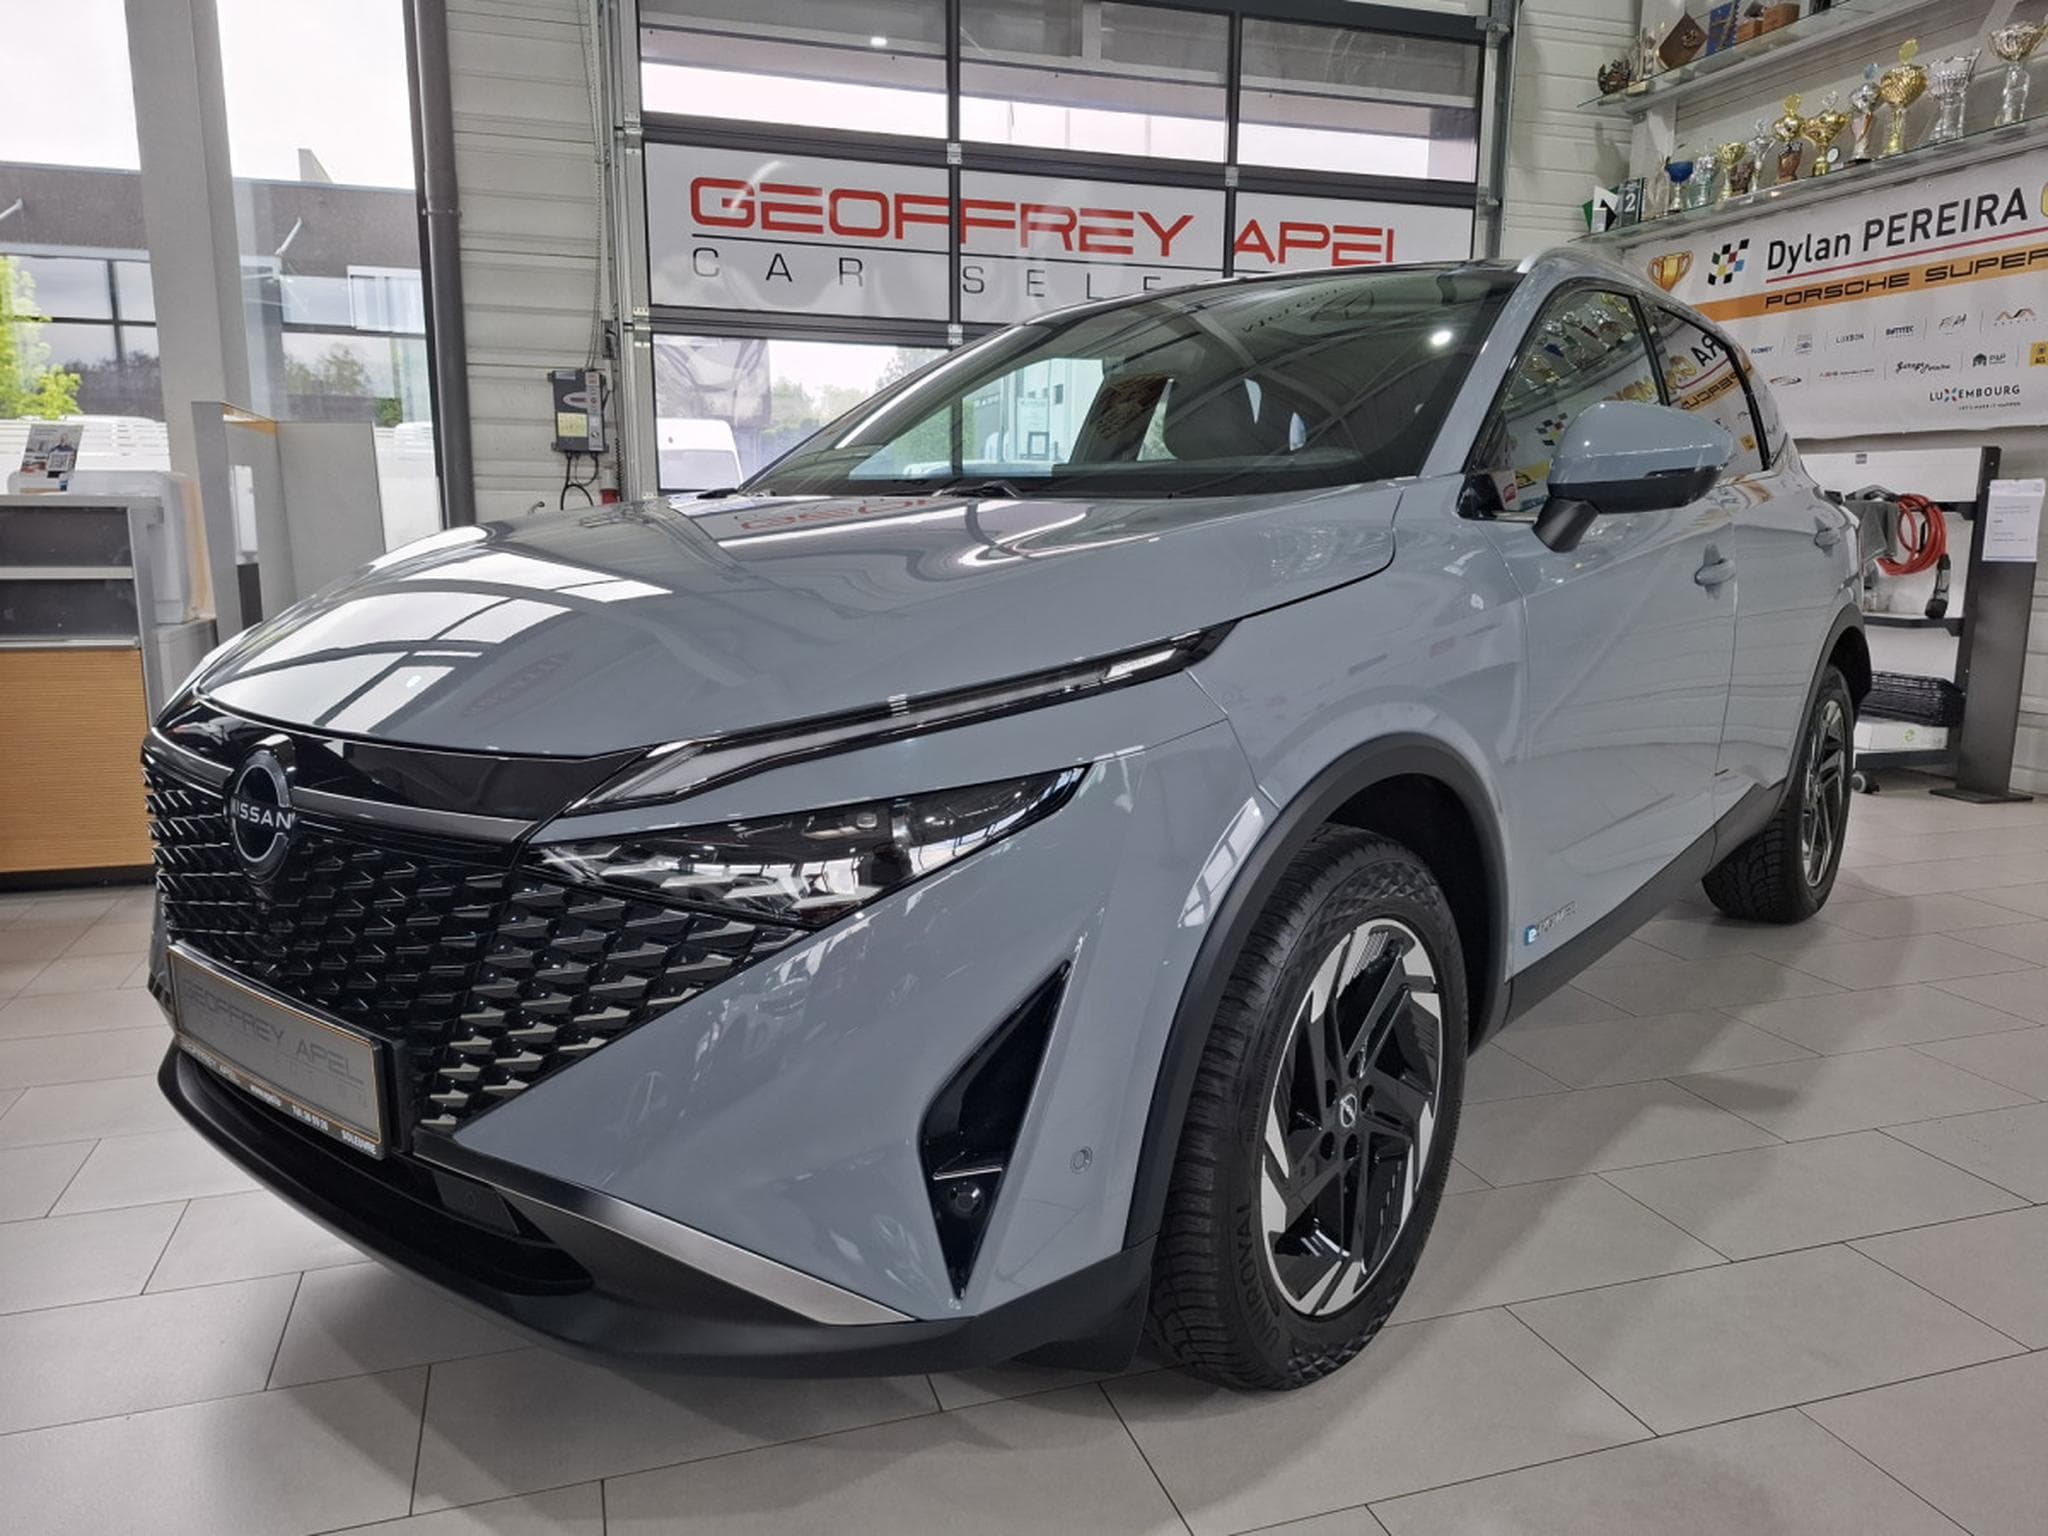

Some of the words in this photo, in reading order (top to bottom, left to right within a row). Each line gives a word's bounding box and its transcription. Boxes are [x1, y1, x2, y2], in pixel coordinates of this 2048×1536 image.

[691, 176, 1194, 257] GEOFFREY
[1767, 233, 1851, 274] Dylan
[1863, 187, 2028, 252] PEREIRA
[692, 247, 864, 288] CAR
[1765, 273, 1910, 309] PORSCHE
[1929, 384, 2021, 403] LUXEMBOURG
[228, 800, 296, 830] ISSAN
[296, 1039, 365, 1086] APEL
[1234, 1189, 1281, 1348] UNIROYAL
